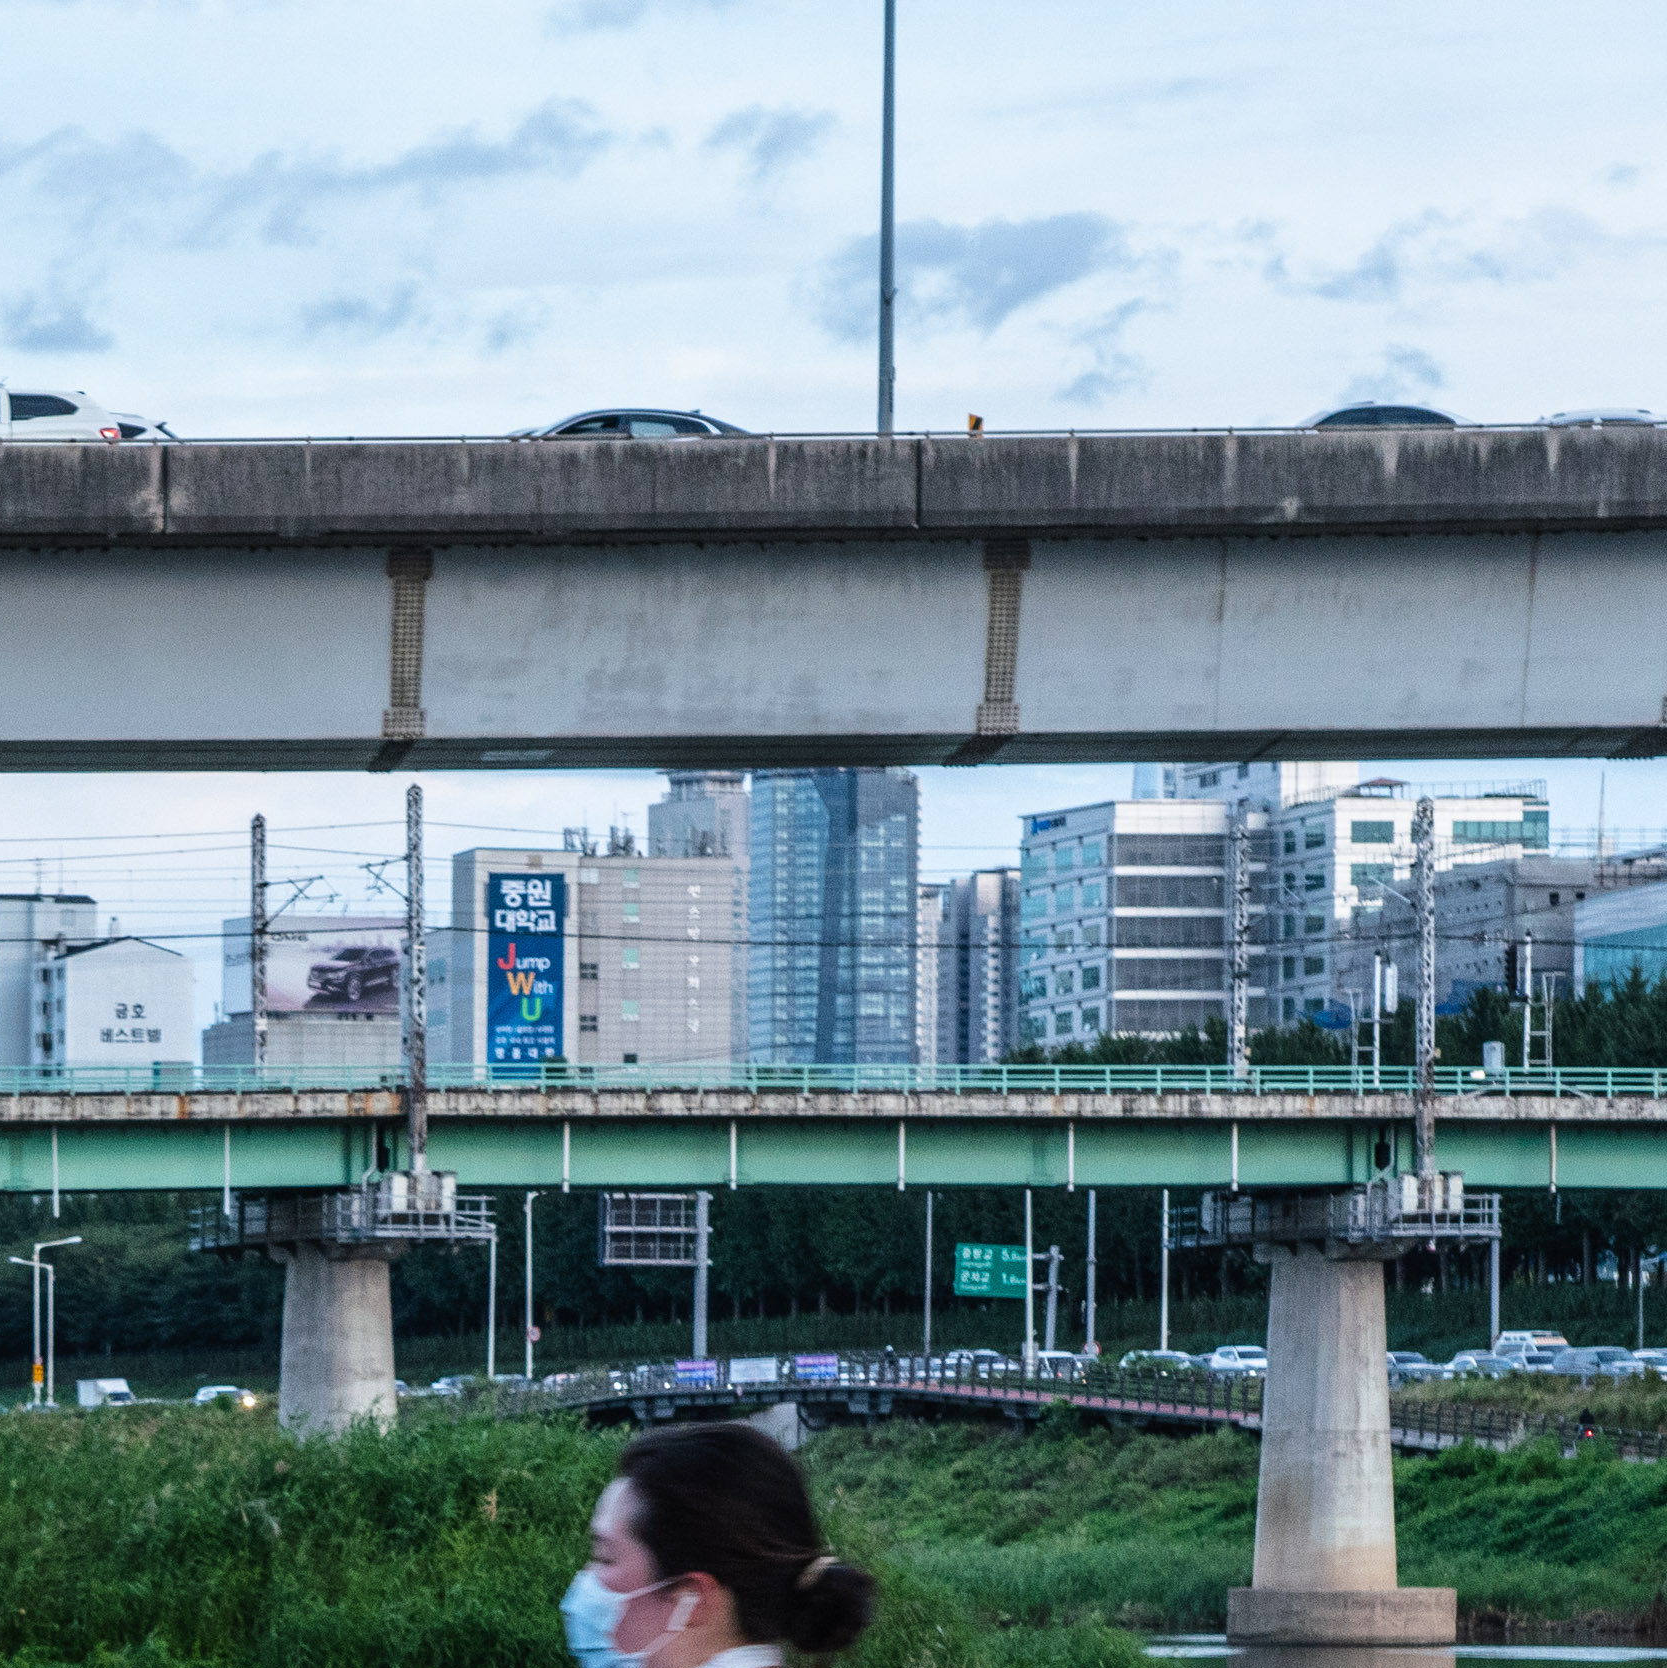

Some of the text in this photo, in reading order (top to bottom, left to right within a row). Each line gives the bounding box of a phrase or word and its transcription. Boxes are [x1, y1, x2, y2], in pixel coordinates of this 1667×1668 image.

[500, 878, 552, 907] 중원
[495, 909, 557, 932] 대학교
[497, 942, 551, 972] Jump
[507, 971, 553, 995] With
[115, 1003, 147, 1019] 금호
[522, 997, 542, 1021] U
